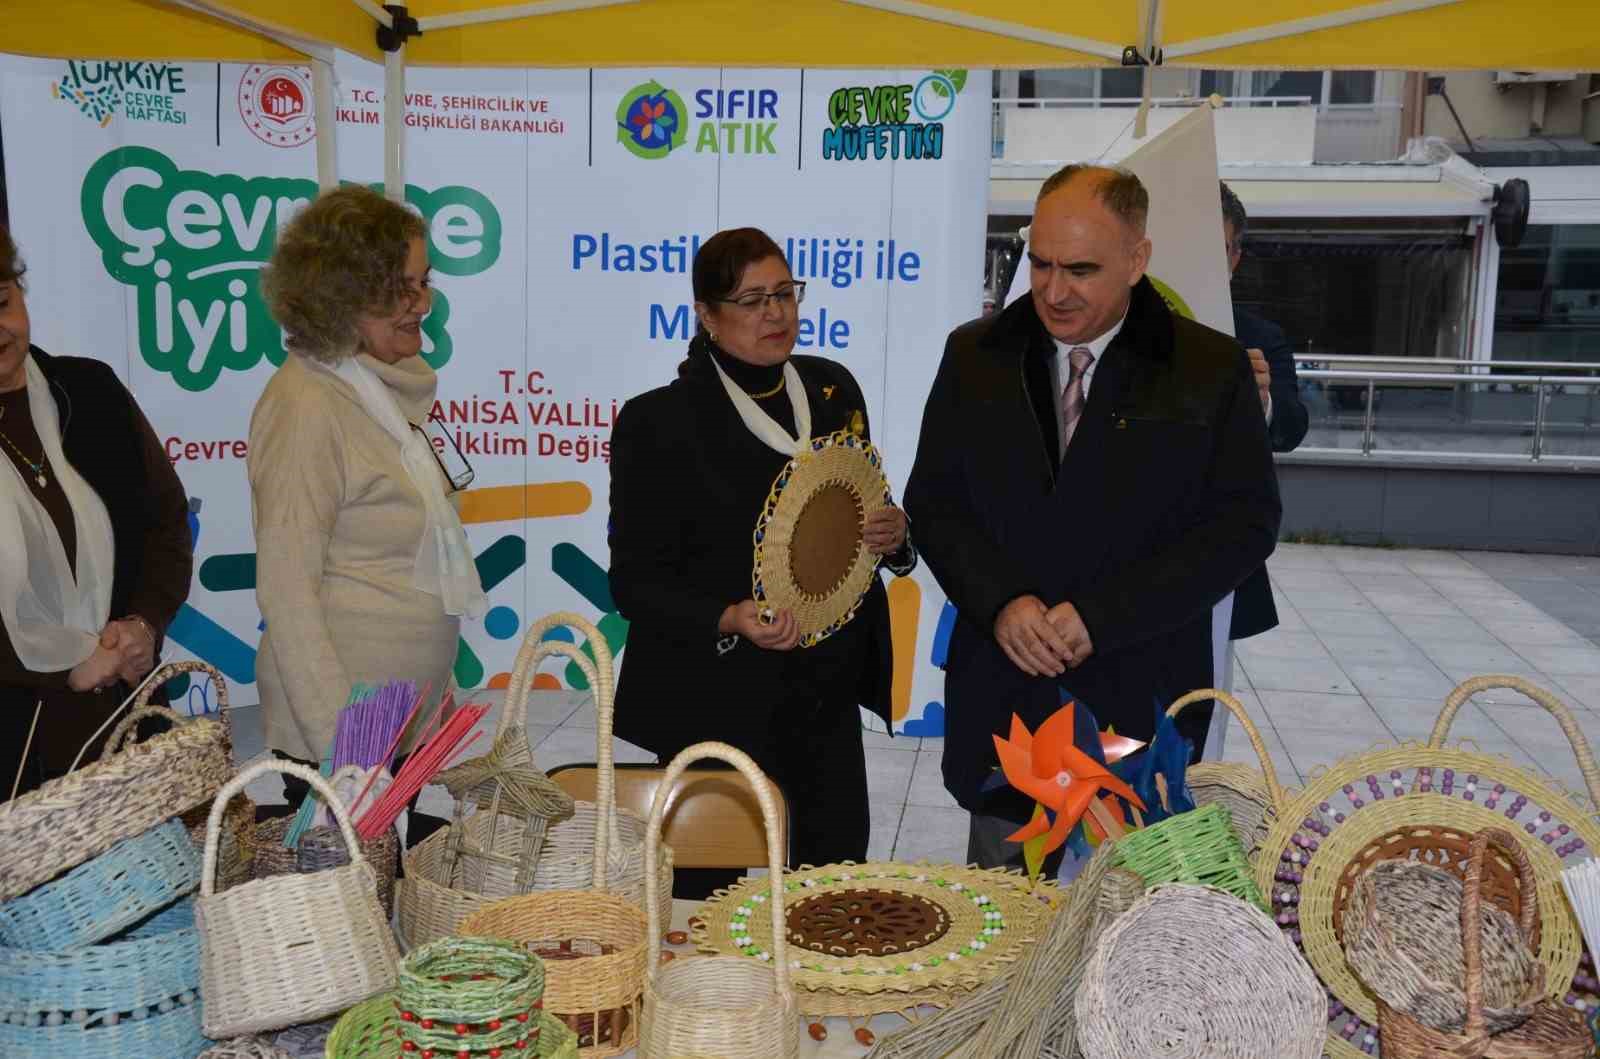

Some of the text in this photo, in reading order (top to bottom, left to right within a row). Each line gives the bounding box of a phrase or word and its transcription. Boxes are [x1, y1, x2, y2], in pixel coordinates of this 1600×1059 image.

[126, 106, 187, 125] HAFTASI
[352, 89, 549, 113] T.C. VRE, ŞEHİRCİLİK VE
[695, 88, 778, 120] SIFIR
[828, 85, 913, 130] ÇEVRE
[335, 106, 564, 134] İKLİM ĞİŞİKLİĞİ BAKANLIĞI
[695, 122, 777, 154] ATIK
[786, 237, 863, 289] liliği
[876, 239, 921, 281] ile
[498, 370, 553, 395] T.C.
[428, 394, 619, 428] ANİSA VALİLİ
[164, 436, 249, 465] Çevre
[455, 425, 527, 456] İklim
[538, 432, 613, 464] Değiş
